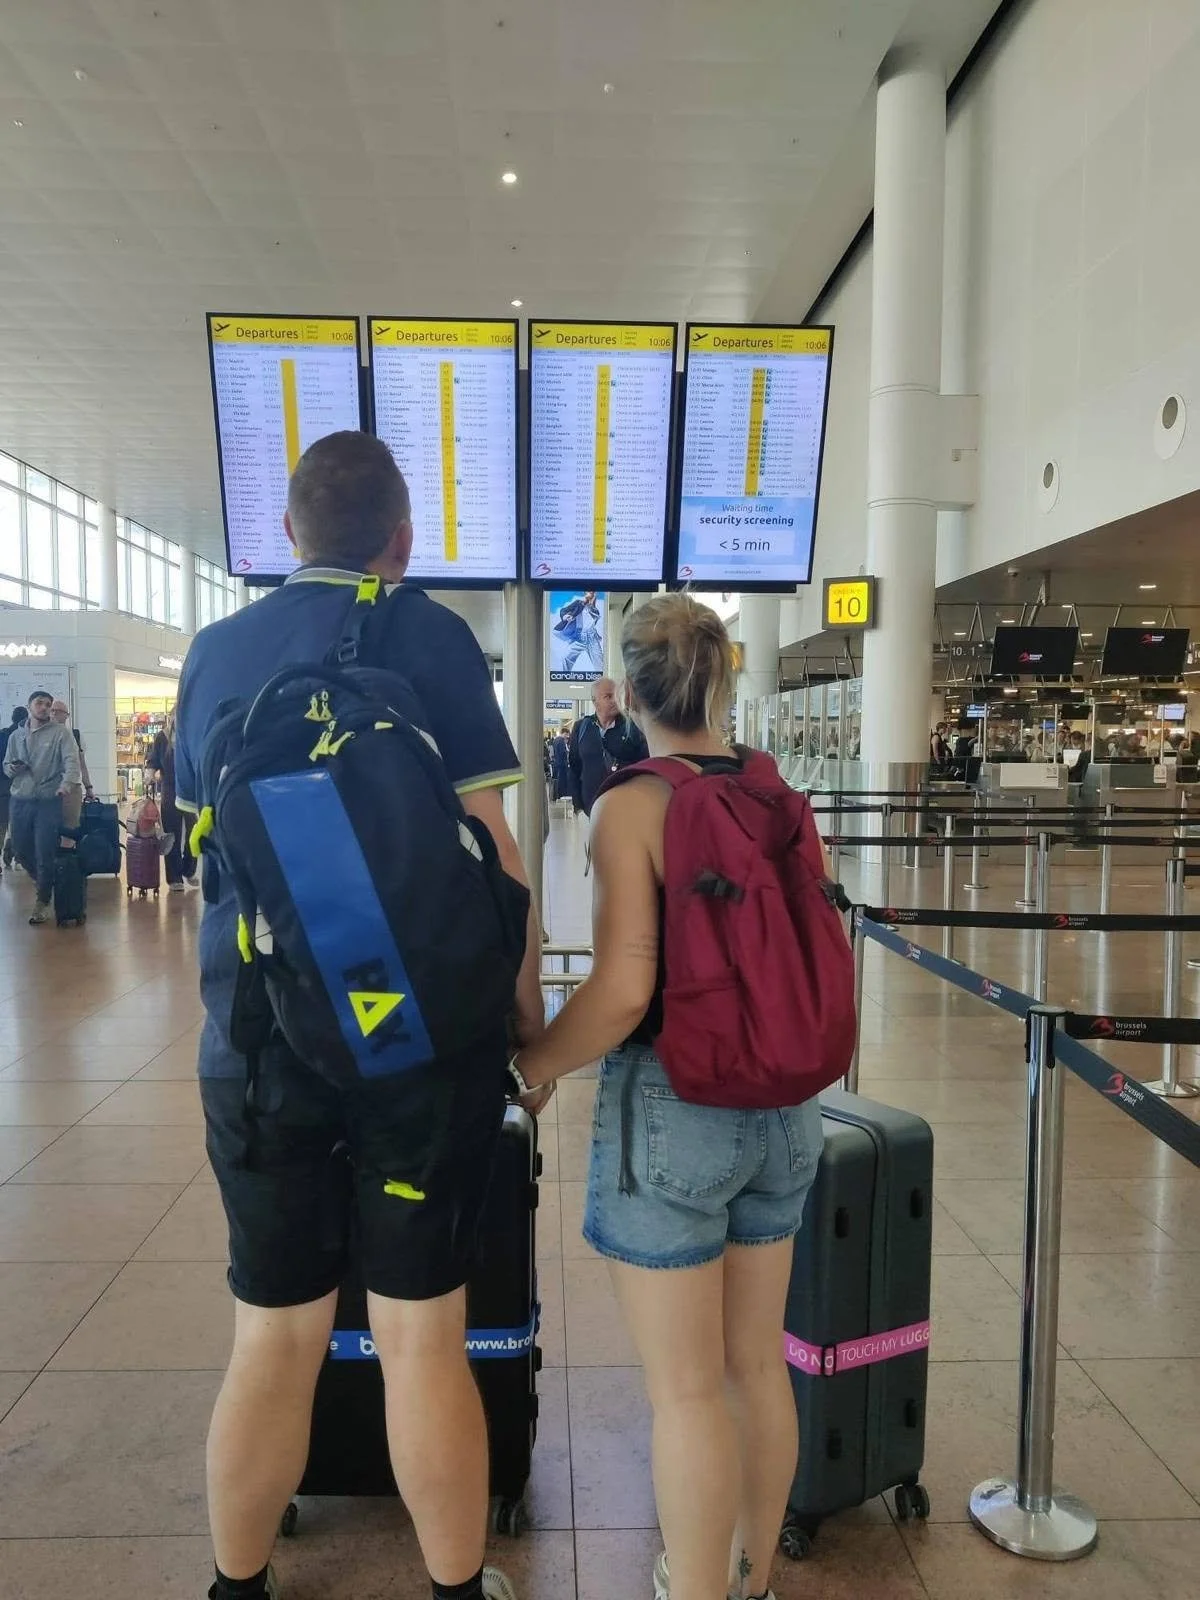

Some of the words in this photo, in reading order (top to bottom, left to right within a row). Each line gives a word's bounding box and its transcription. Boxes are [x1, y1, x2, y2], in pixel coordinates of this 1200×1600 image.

[236, 327, 298, 339] Departures
[332, 332, 353, 341] 10:06
[396, 330, 458, 342] Departures
[490, 335, 512, 343] 10:06
[556, 333, 617, 345] Departures
[649, 338, 671, 347] 10:06
[713, 337, 774, 349] Departures
[805, 341, 827, 349] 10:06
[722, 504, 753, 513] Waiting
[755, 504, 774, 512] time
[700, 515, 742, 526] security
[744, 516, 794, 526] screening
[732, 538, 740, 551] 5
[744, 538, 771, 551] min
[834, 597, 861, 617] 10
[551, 672, 584, 680] caroline
[585, 672, 602, 680] biss
[1115, 1021, 1147, 1029] brussels
[1115, 1029, 1141, 1037] airport
[1123, 1081, 1145, 1102] brussels
[1119, 1090, 1137, 1107] airport
[789, 1343, 808, 1362] DO
[810, 1353, 839, 1368] NO
[842, 1341, 880, 1362] TOUCH
[881, 1336, 898, 1351] MY
